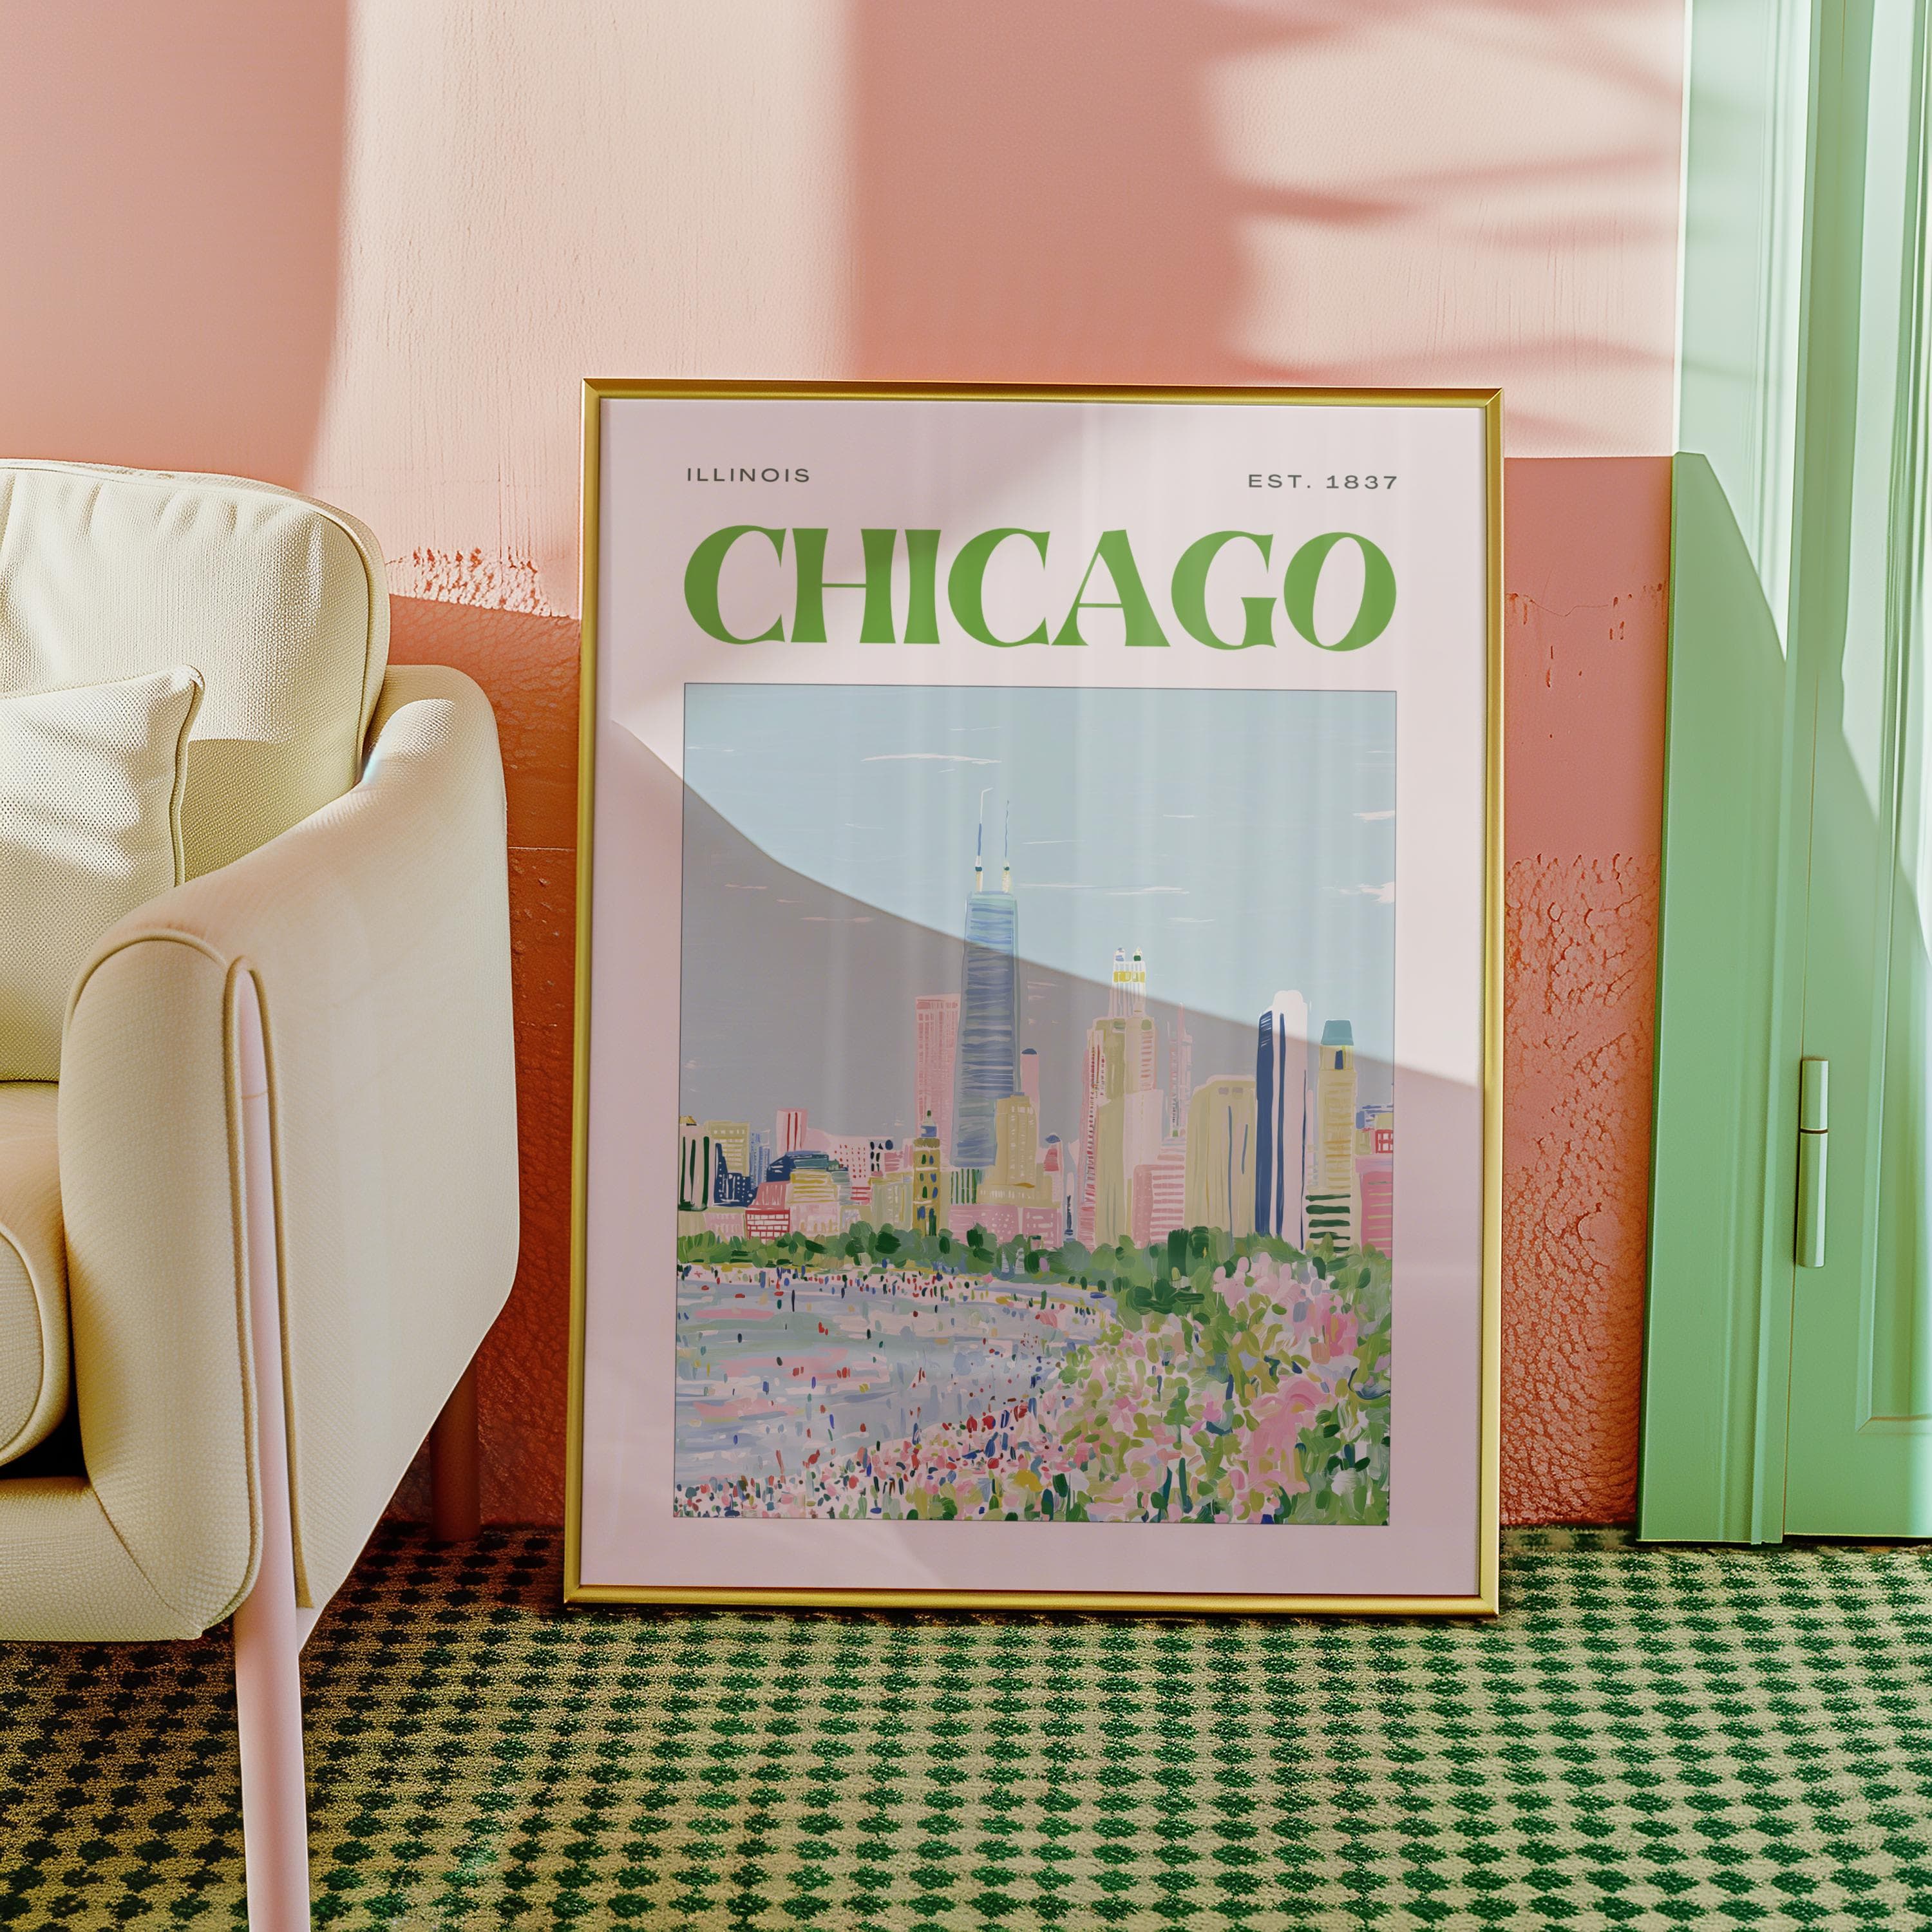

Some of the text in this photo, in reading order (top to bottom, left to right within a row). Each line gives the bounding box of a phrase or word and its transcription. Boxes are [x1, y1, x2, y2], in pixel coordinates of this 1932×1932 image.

[687, 468, 810, 483] ILLINOIS
[1248, 474, 1398, 489] EST. 1837
[684, 525, 1397, 652] CHICAGO
